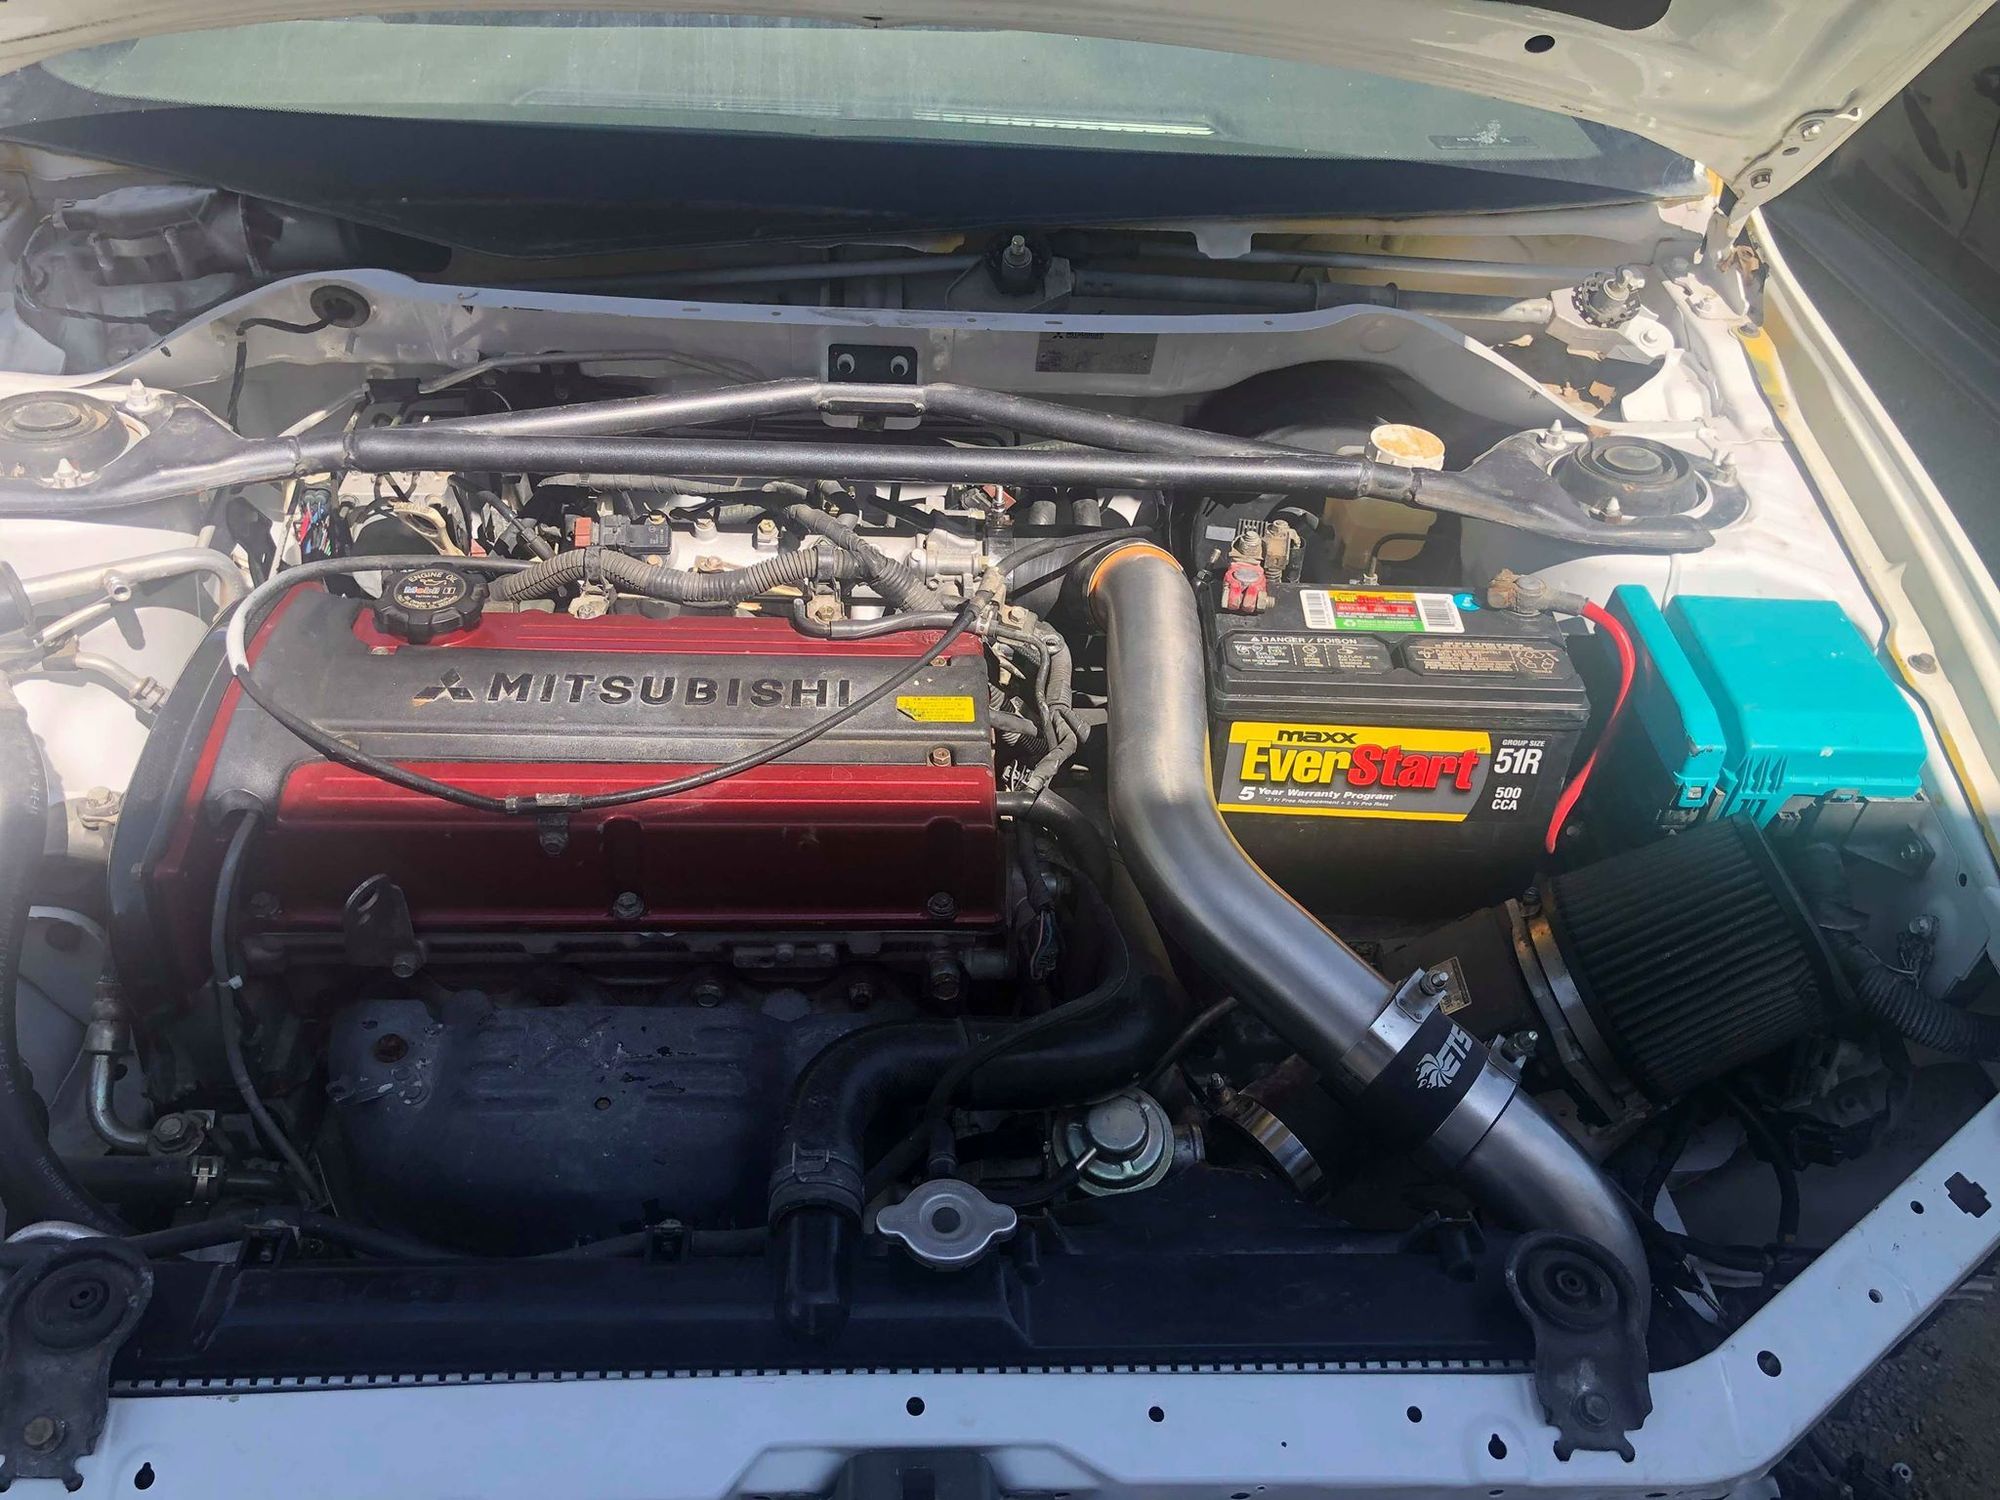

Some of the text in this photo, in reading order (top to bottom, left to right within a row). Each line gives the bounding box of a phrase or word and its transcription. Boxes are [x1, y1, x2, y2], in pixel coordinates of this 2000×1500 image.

[407, 571, 444, 583] ENGINE
[403, 585, 440, 594] Mobil
[1316, 637, 1358, 645] POISON
[487, 672, 851, 708] MITSUBISHI
[1277, 730, 1358, 744] maxx
[1529, 739, 1546, 747] SIZE
[1240, 739, 1480, 791] EverStart
[1493, 747, 1543, 775] 51R
[1238, 786, 1256, 801] 5
[1258, 787, 1285, 796] Year
[1287, 788, 1343, 800] Warranty
[1494, 786, 1522, 799] 500
[1297, 798, 1340, 806] Replacement
[1491, 799, 1518, 811] CCA
[1435, 1023, 1473, 1077] ETS
